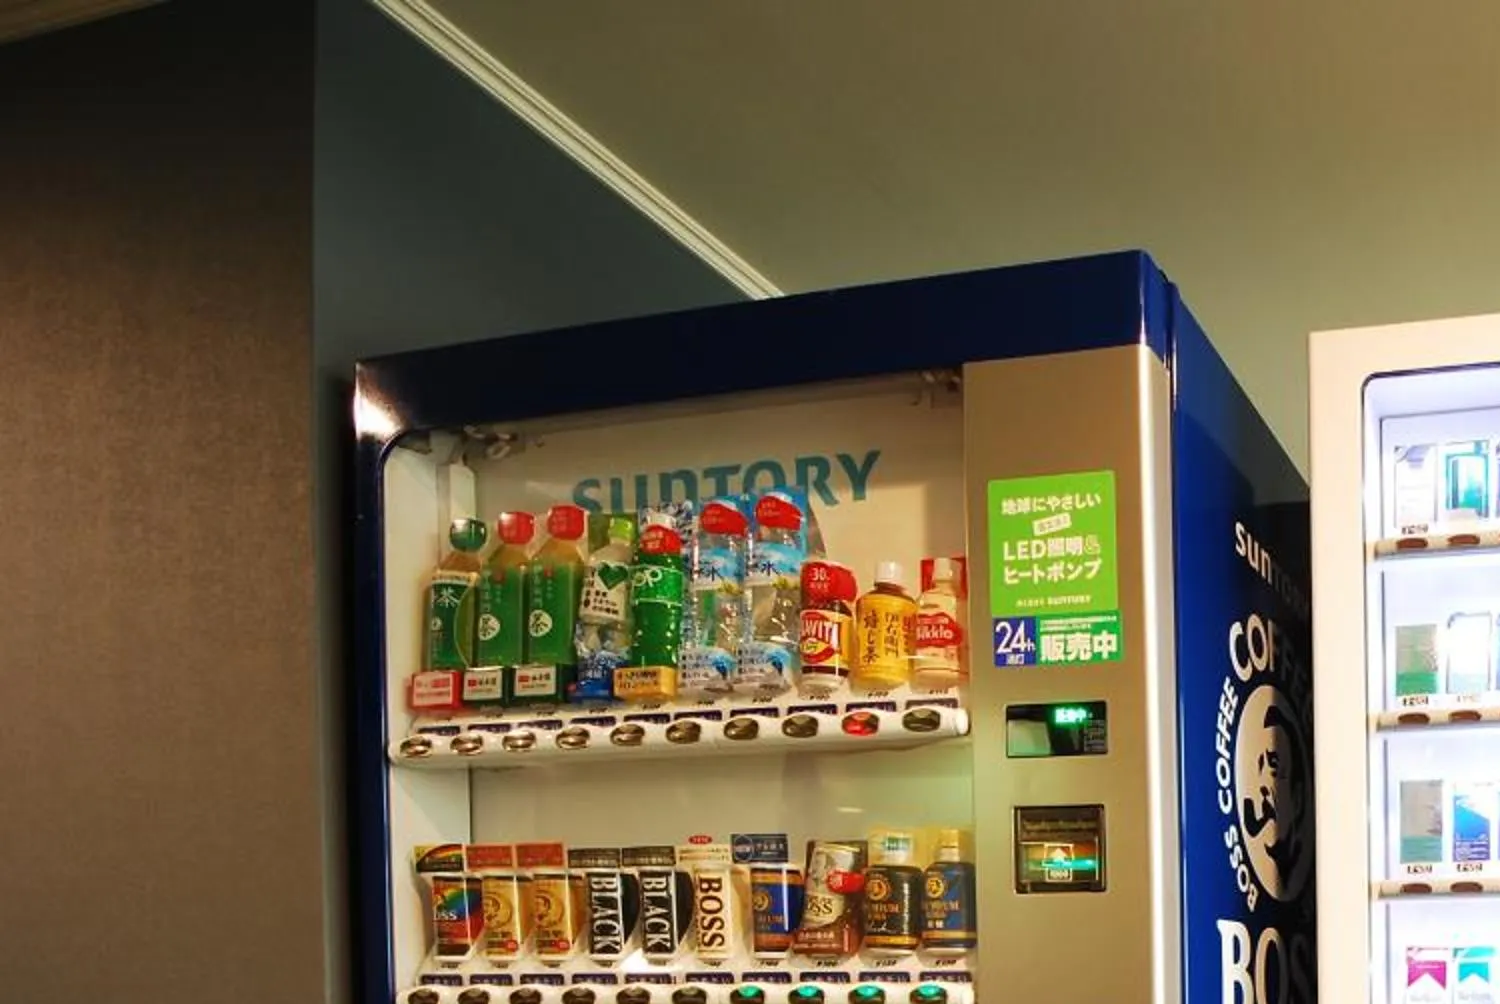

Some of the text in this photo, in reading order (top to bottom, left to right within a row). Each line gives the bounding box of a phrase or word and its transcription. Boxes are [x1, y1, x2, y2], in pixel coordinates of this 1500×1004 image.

[1001, 493, 1102, 515] 地球にやさしい
[1004, 557, 1103, 584] ヒートポンプ
[995, 620, 1036, 654] 24h
[1040, 630, 1117, 663] 販売中
[1215, 675, 1239, 816] COFFEE
[1223, 821, 1260, 913] BOSS
[590, 876, 622, 954] BLACK
[642, 876, 671, 953] BLACK
[699, 876, 725, 949] BOSS
